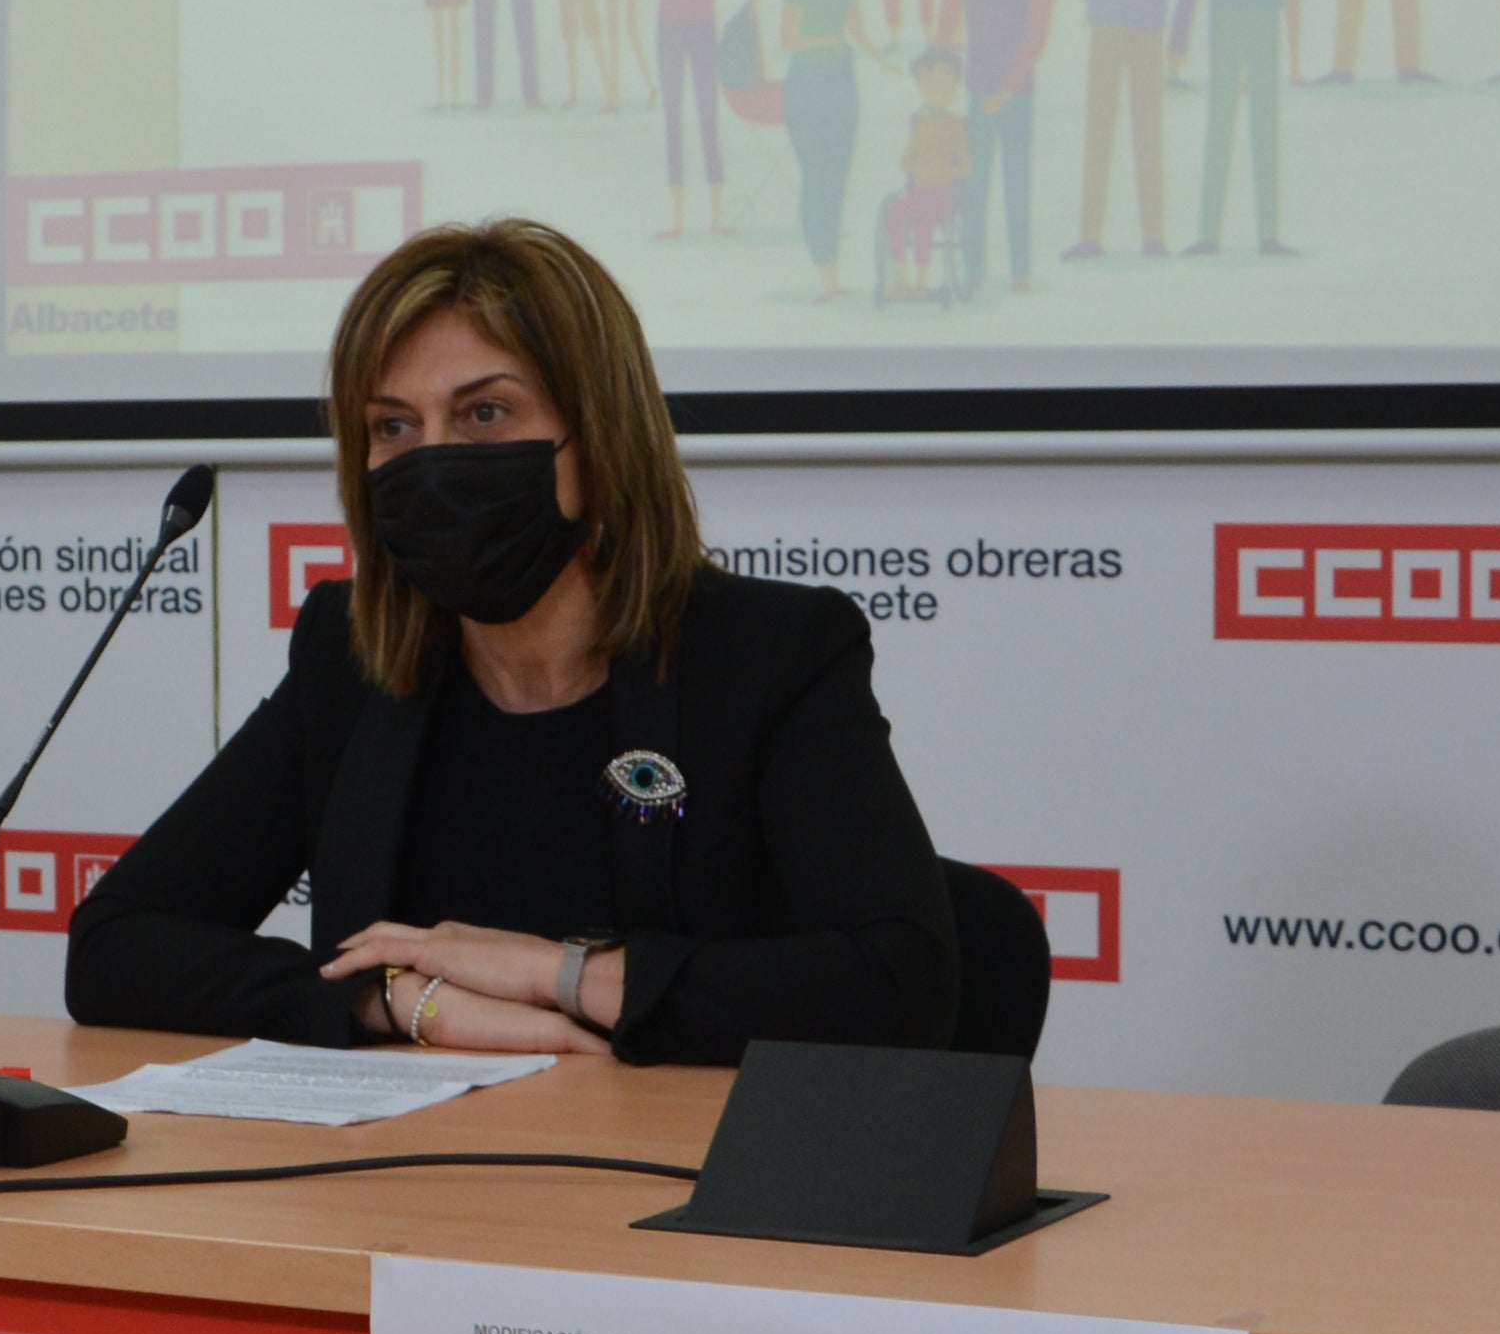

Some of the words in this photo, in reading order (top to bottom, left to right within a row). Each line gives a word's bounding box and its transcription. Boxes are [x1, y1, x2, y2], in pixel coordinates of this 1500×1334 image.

[28, 189, 285, 263] CCOO
[10, 300, 177, 336] Albacete
[708, 538, 930, 577] omisiones
[946, 538, 1123, 579] obreras
